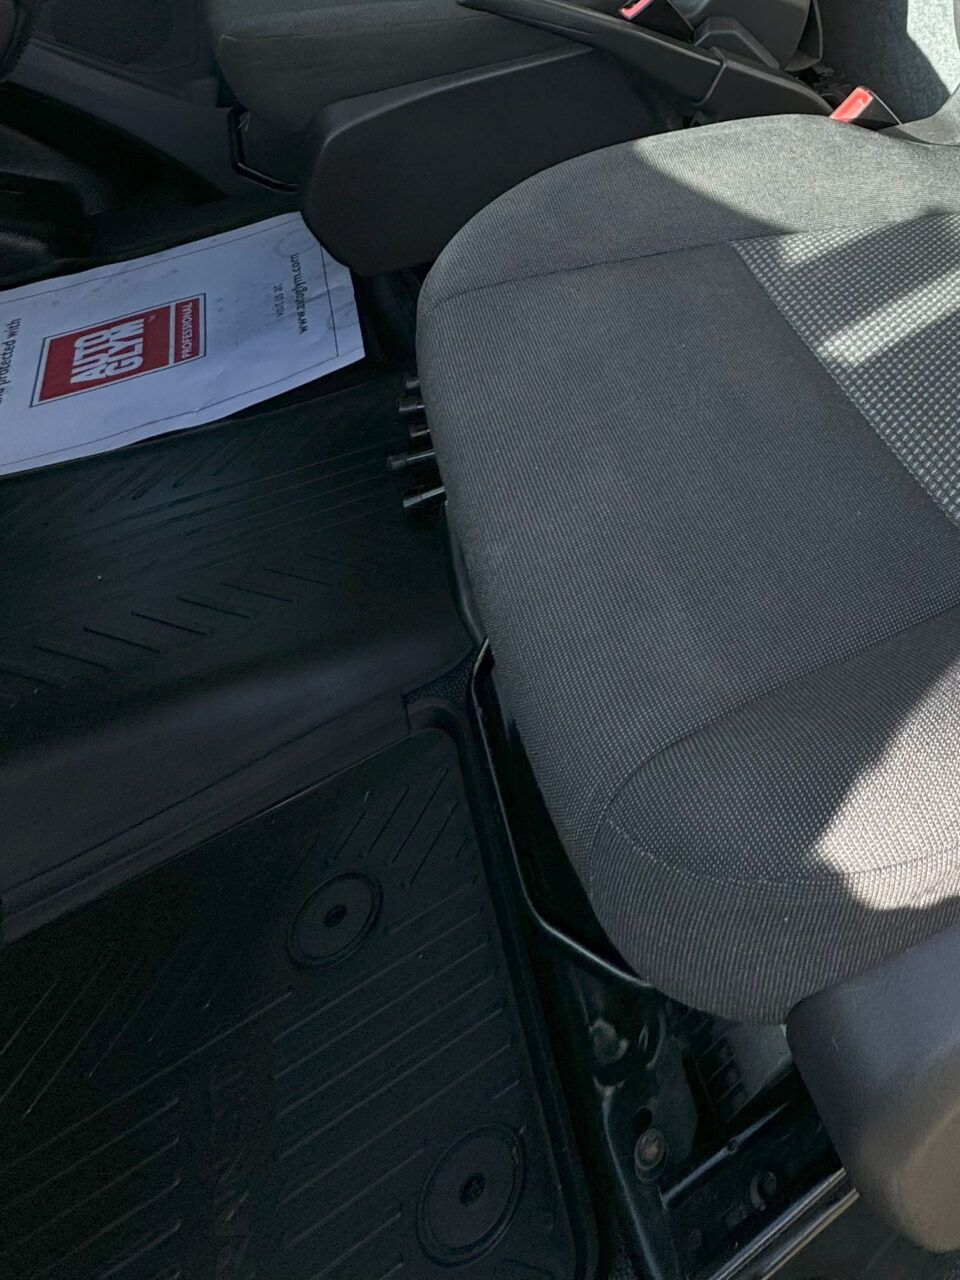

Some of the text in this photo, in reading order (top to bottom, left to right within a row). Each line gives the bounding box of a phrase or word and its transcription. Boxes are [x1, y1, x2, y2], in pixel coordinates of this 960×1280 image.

[290, 252, 308, 335] www.autoglym.com
[0, 318, 22, 384] protected with
[70, 328, 113, 384] AUTO
[104, 318, 145, 377] GLYM
[181, 302, 193, 359] PROFESSIONAL
